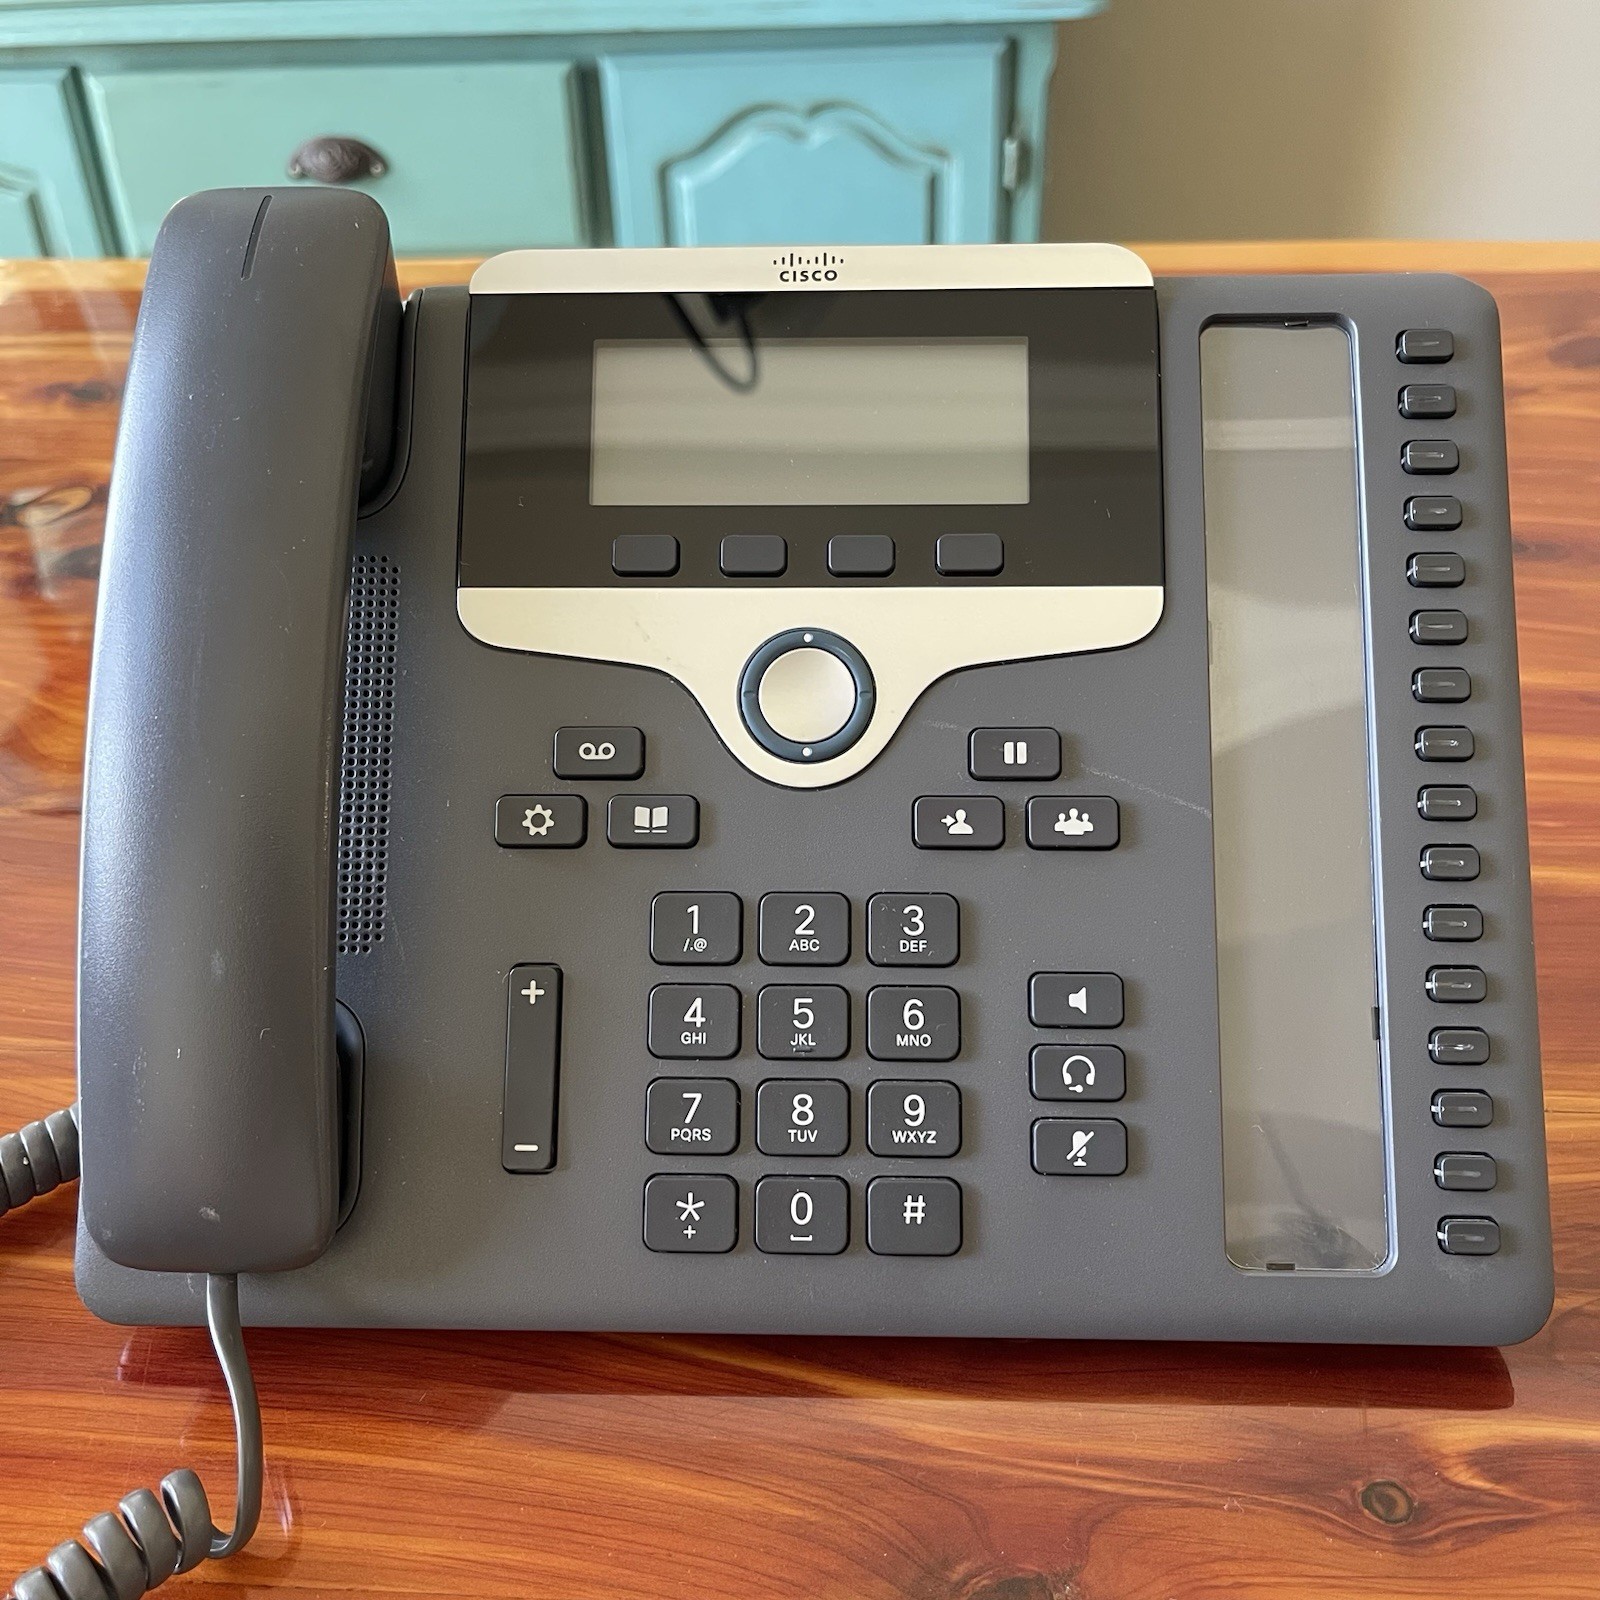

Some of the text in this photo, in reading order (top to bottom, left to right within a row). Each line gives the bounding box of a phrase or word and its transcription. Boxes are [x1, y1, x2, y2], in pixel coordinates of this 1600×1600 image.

[779, 269, 838, 283] CISCO
[686, 904, 699, 935] 1
[794, 904, 815, 936] 2
[902, 904, 925, 937] 3
[788, 938, 820, 952] ABC
[899, 939, 928, 953] DEF
[683, 997, 706, 1028] 4
[792, 997, 815, 1029] 5
[903, 998, 925, 1031] 6
[680, 1031, 707, 1045] GHI
[789, 1032, 817, 1047] JKL
[896, 1033, 932, 1047] MNO
[682, 1092, 702, 1124] 7
[791, 1093, 814, 1126] 8
[903, 1094, 926, 1127] 9
[670, 1127, 712, 1143] PQRS
[787, 1129, 818, 1143] TUV
[891, 1129, 937, 1144] WXYZ
[790, 1192, 813, 1226] 0
